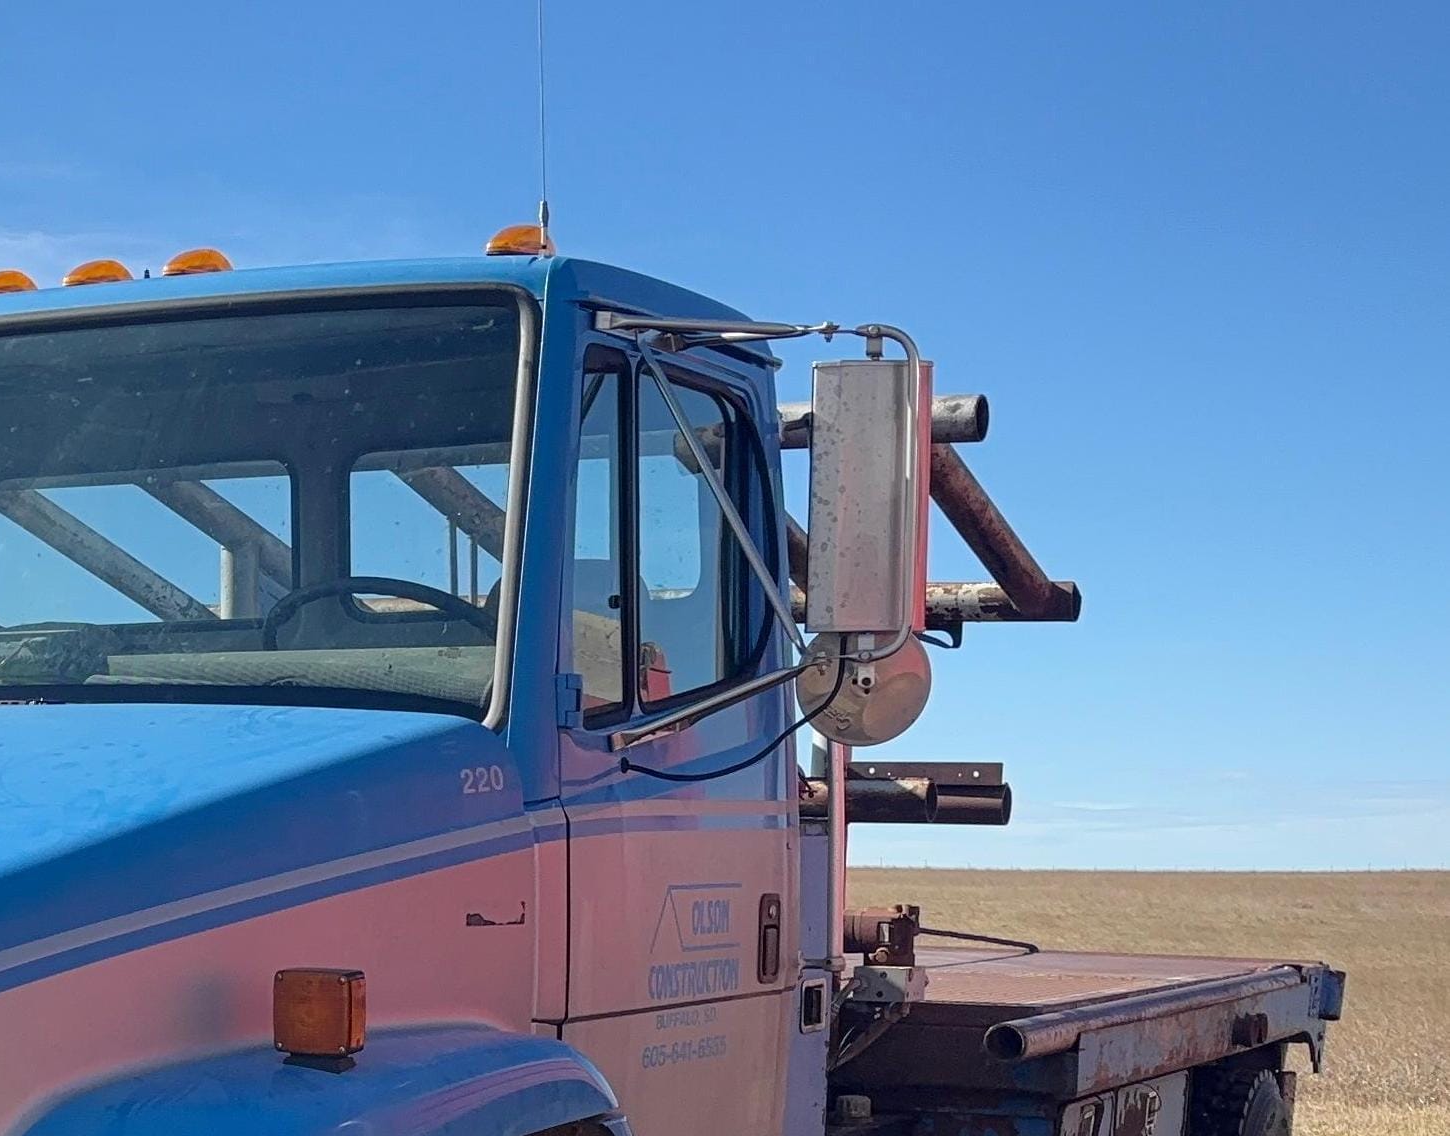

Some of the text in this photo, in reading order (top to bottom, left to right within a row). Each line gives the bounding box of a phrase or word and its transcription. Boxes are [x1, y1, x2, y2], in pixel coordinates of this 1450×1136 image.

[460, 765, 504, 794] 220
[692, 900, 730, 936] OLSON
[648, 958, 740, 1000] CONSTRUCTION
